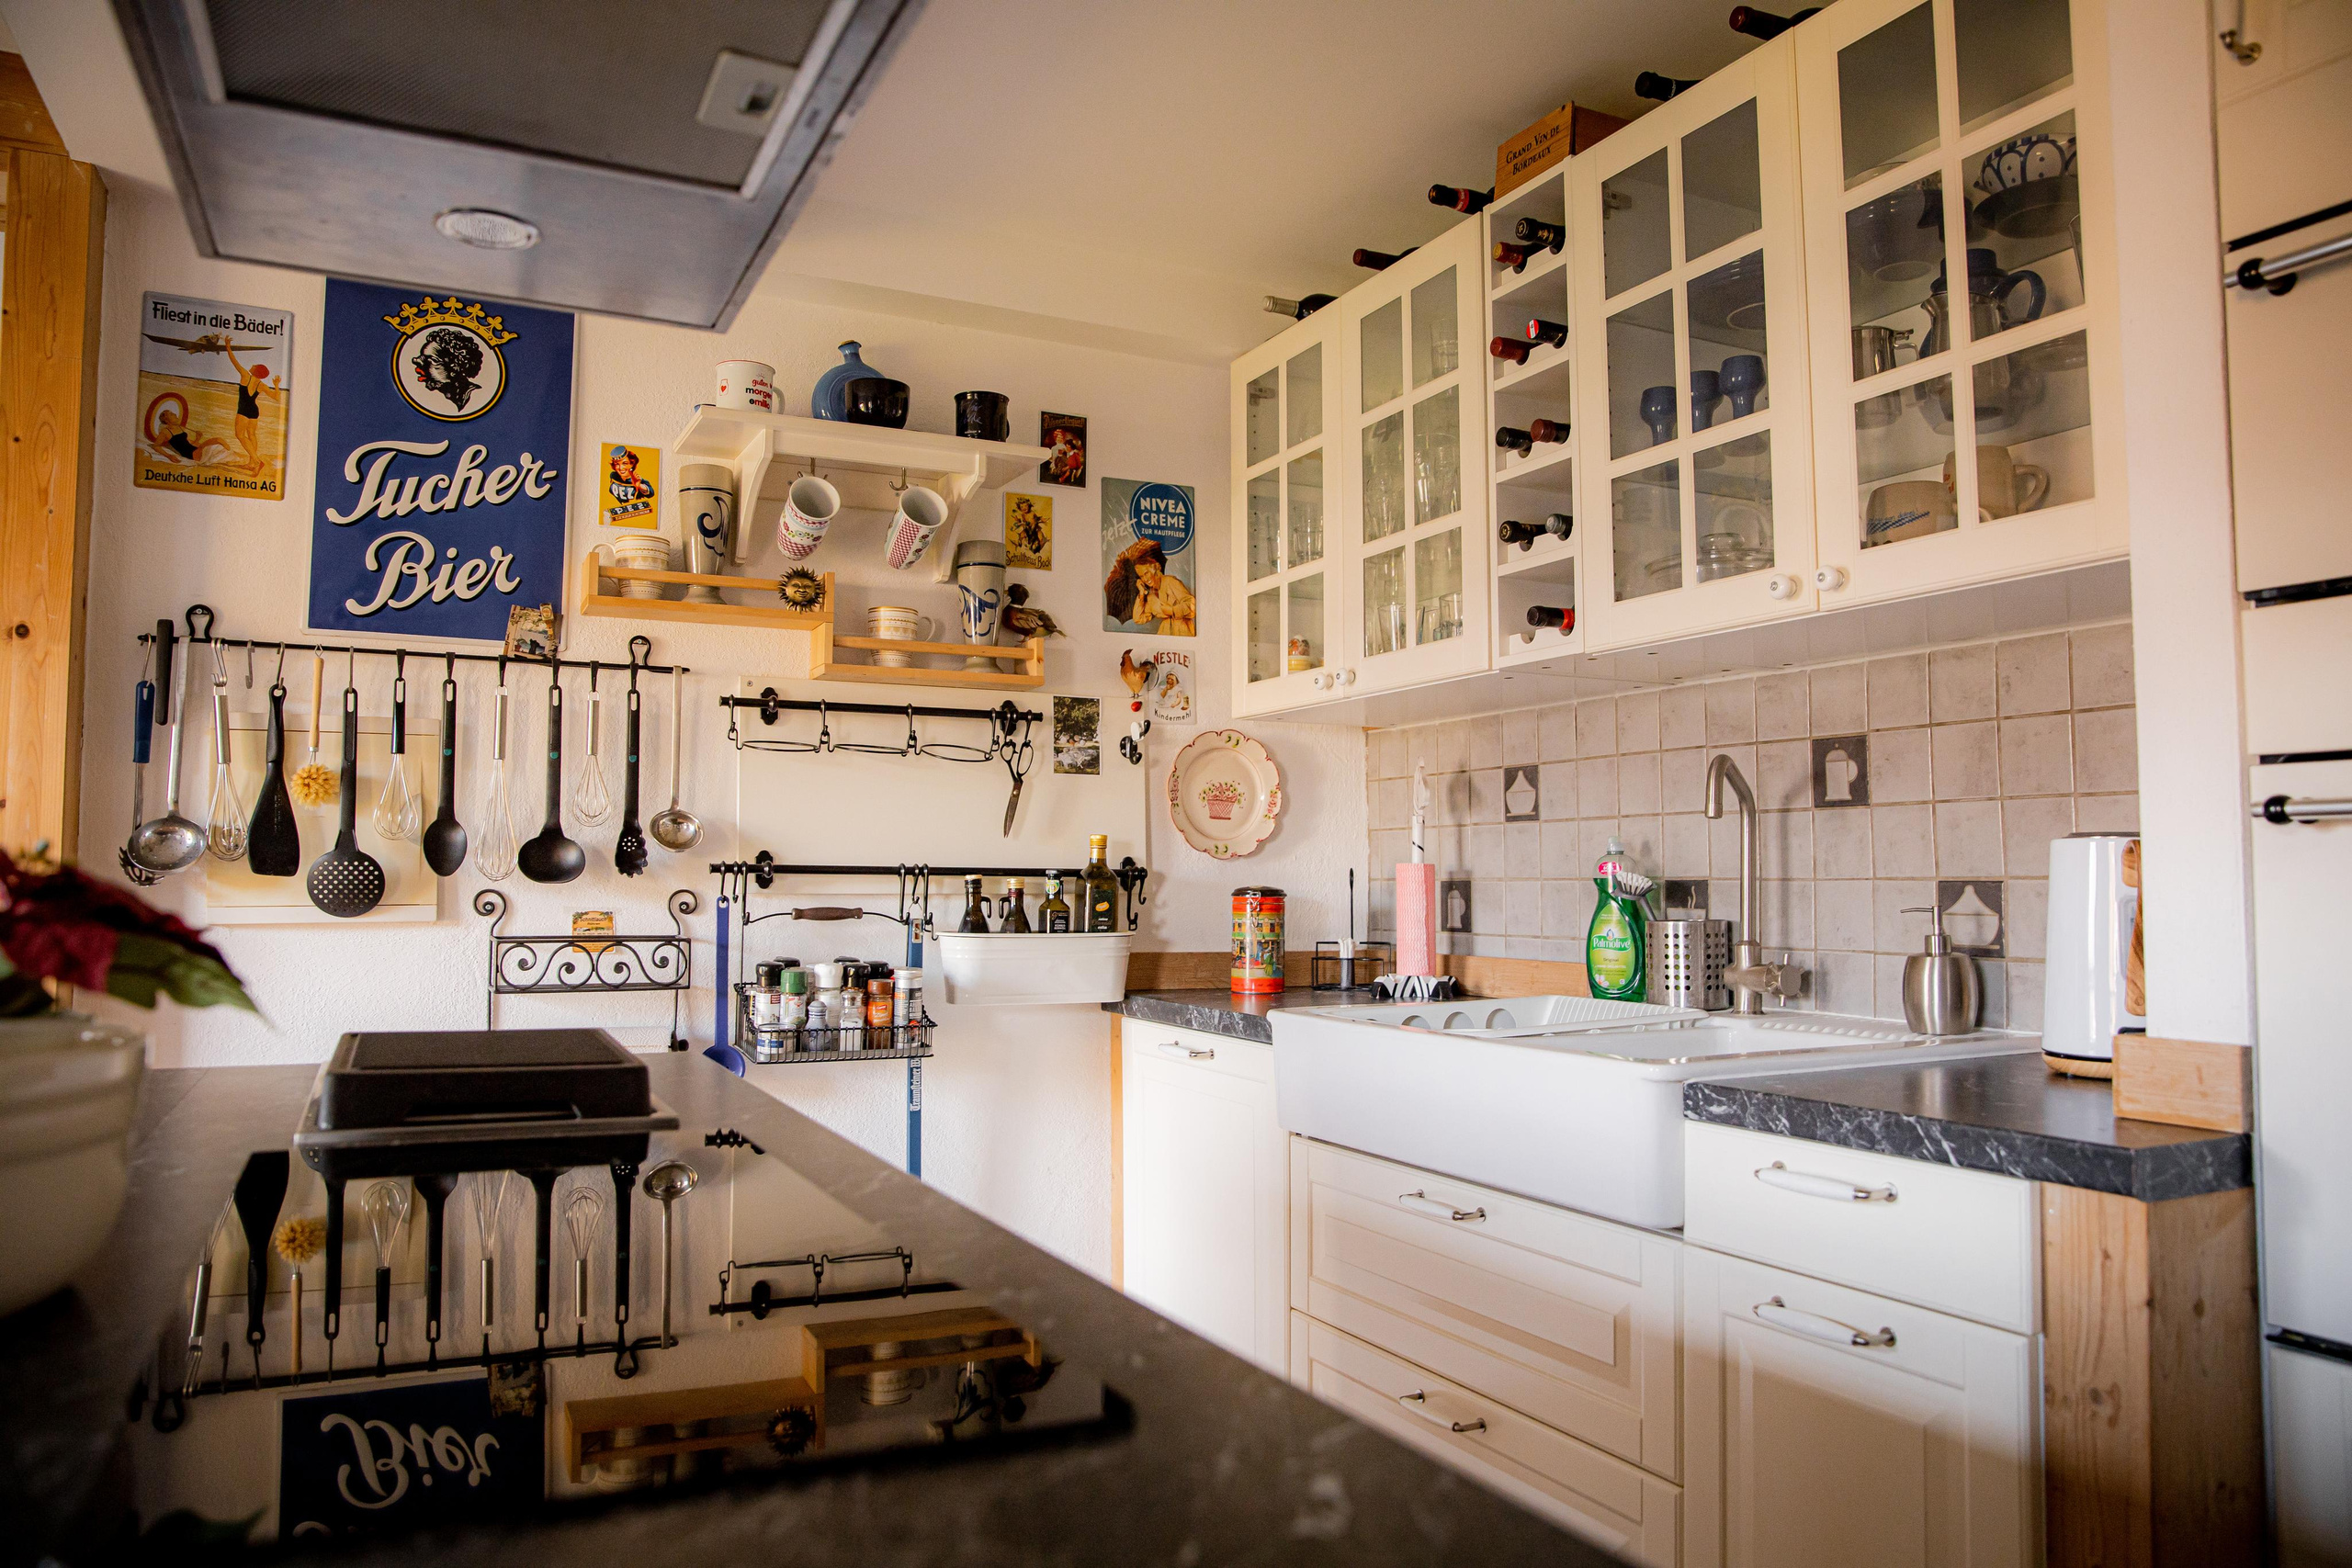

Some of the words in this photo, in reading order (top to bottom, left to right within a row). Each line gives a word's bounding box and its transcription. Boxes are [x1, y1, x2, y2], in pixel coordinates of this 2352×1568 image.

[1512, 145, 1552, 175] BORDEAUX
[153, 300, 192, 322] Fliegt
[194, 311, 207, 326] in
[209, 314, 232, 330] die
[233, 313, 285, 336] Bäder!
[144, 468, 194, 484] Deutsche
[196, 474, 221, 487] Luft
[224, 477, 257, 491] Hansa
[260, 480, 277, 492] AG
[326, 439, 559, 525] Tucher-
[611, 483, 635, 501] PEZ
[1139, 497, 1187, 514] NIVEA
[1140, 512, 1185, 529] CREME
[1154, 529, 1185, 538] HAUTPFLEGE
[345, 531, 522, 616] Bier
[1154, 708, 1192, 722] Kindermehl
[1593, 937, 1632, 949] Palmolive
